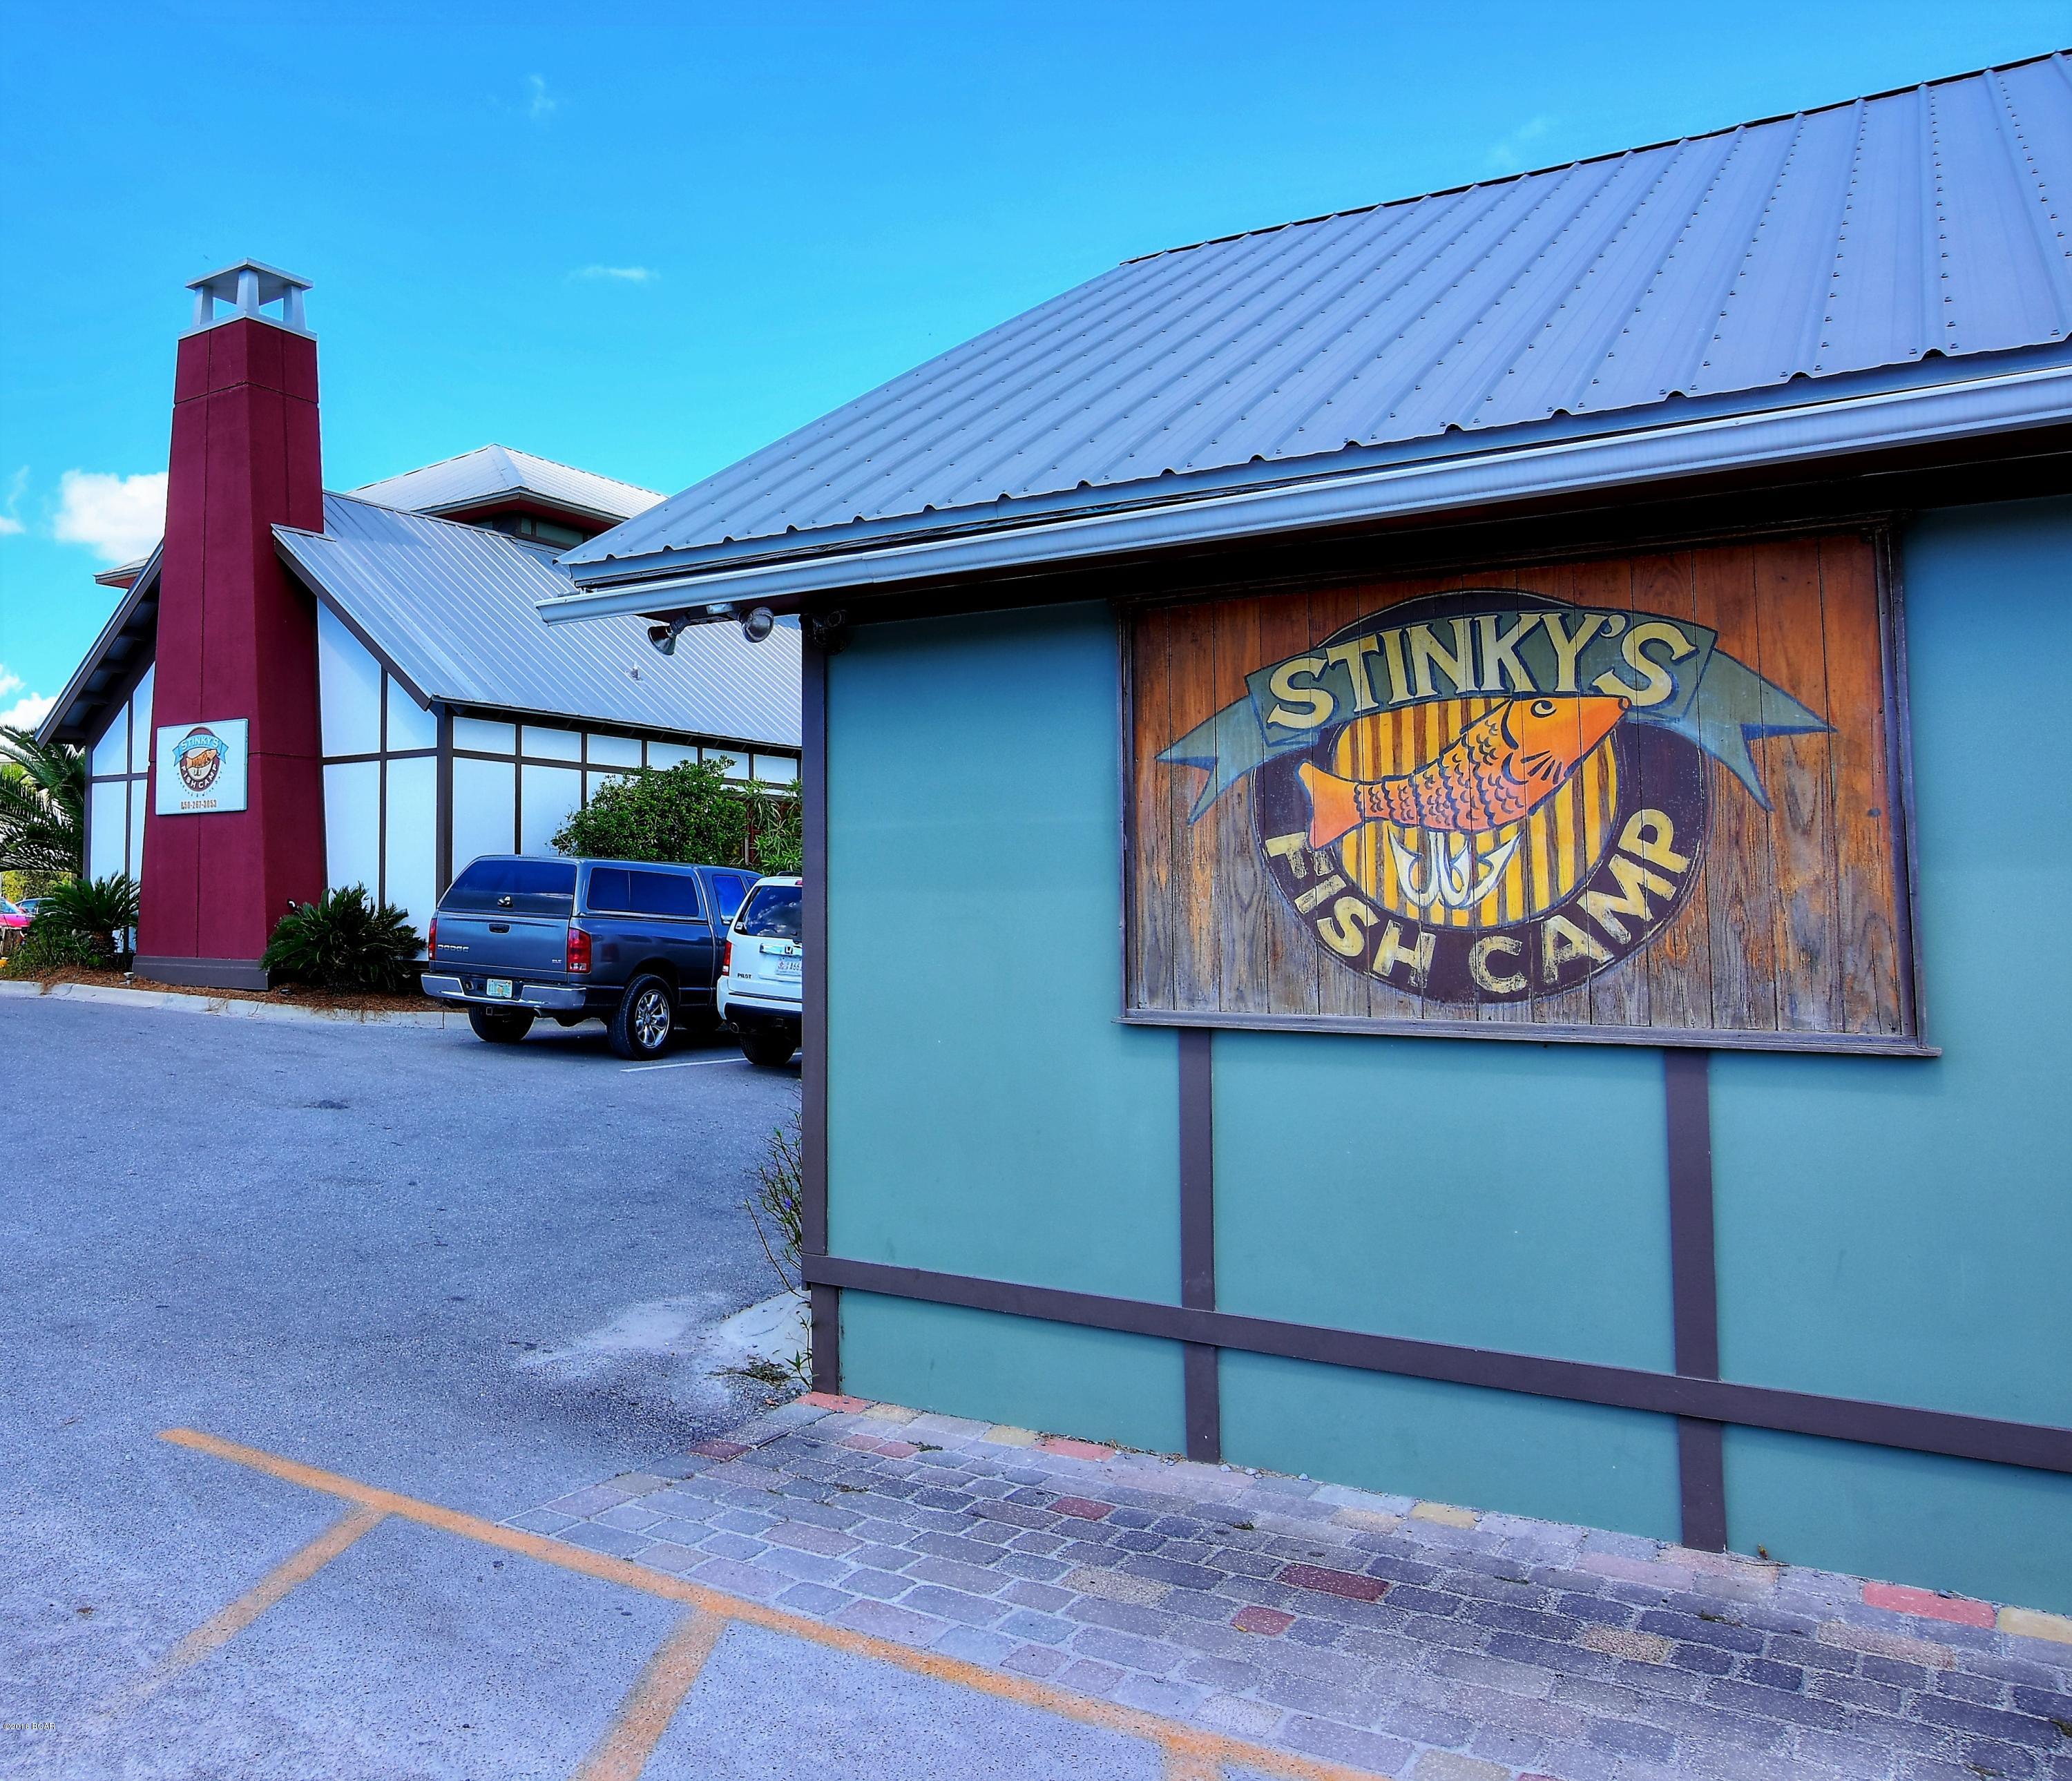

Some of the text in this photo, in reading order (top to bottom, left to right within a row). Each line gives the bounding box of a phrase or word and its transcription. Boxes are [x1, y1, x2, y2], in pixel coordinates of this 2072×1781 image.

[1266, 613, 1698, 729] STINKY'S
[180, 737, 219, 749] STINKY'S
[181, 766, 196, 788] FISH
[199, 764, 217, 788] CAMP
[1265, 809, 1690, 994] FISH CAMP
[437, 944, 469, 952] DODGE
